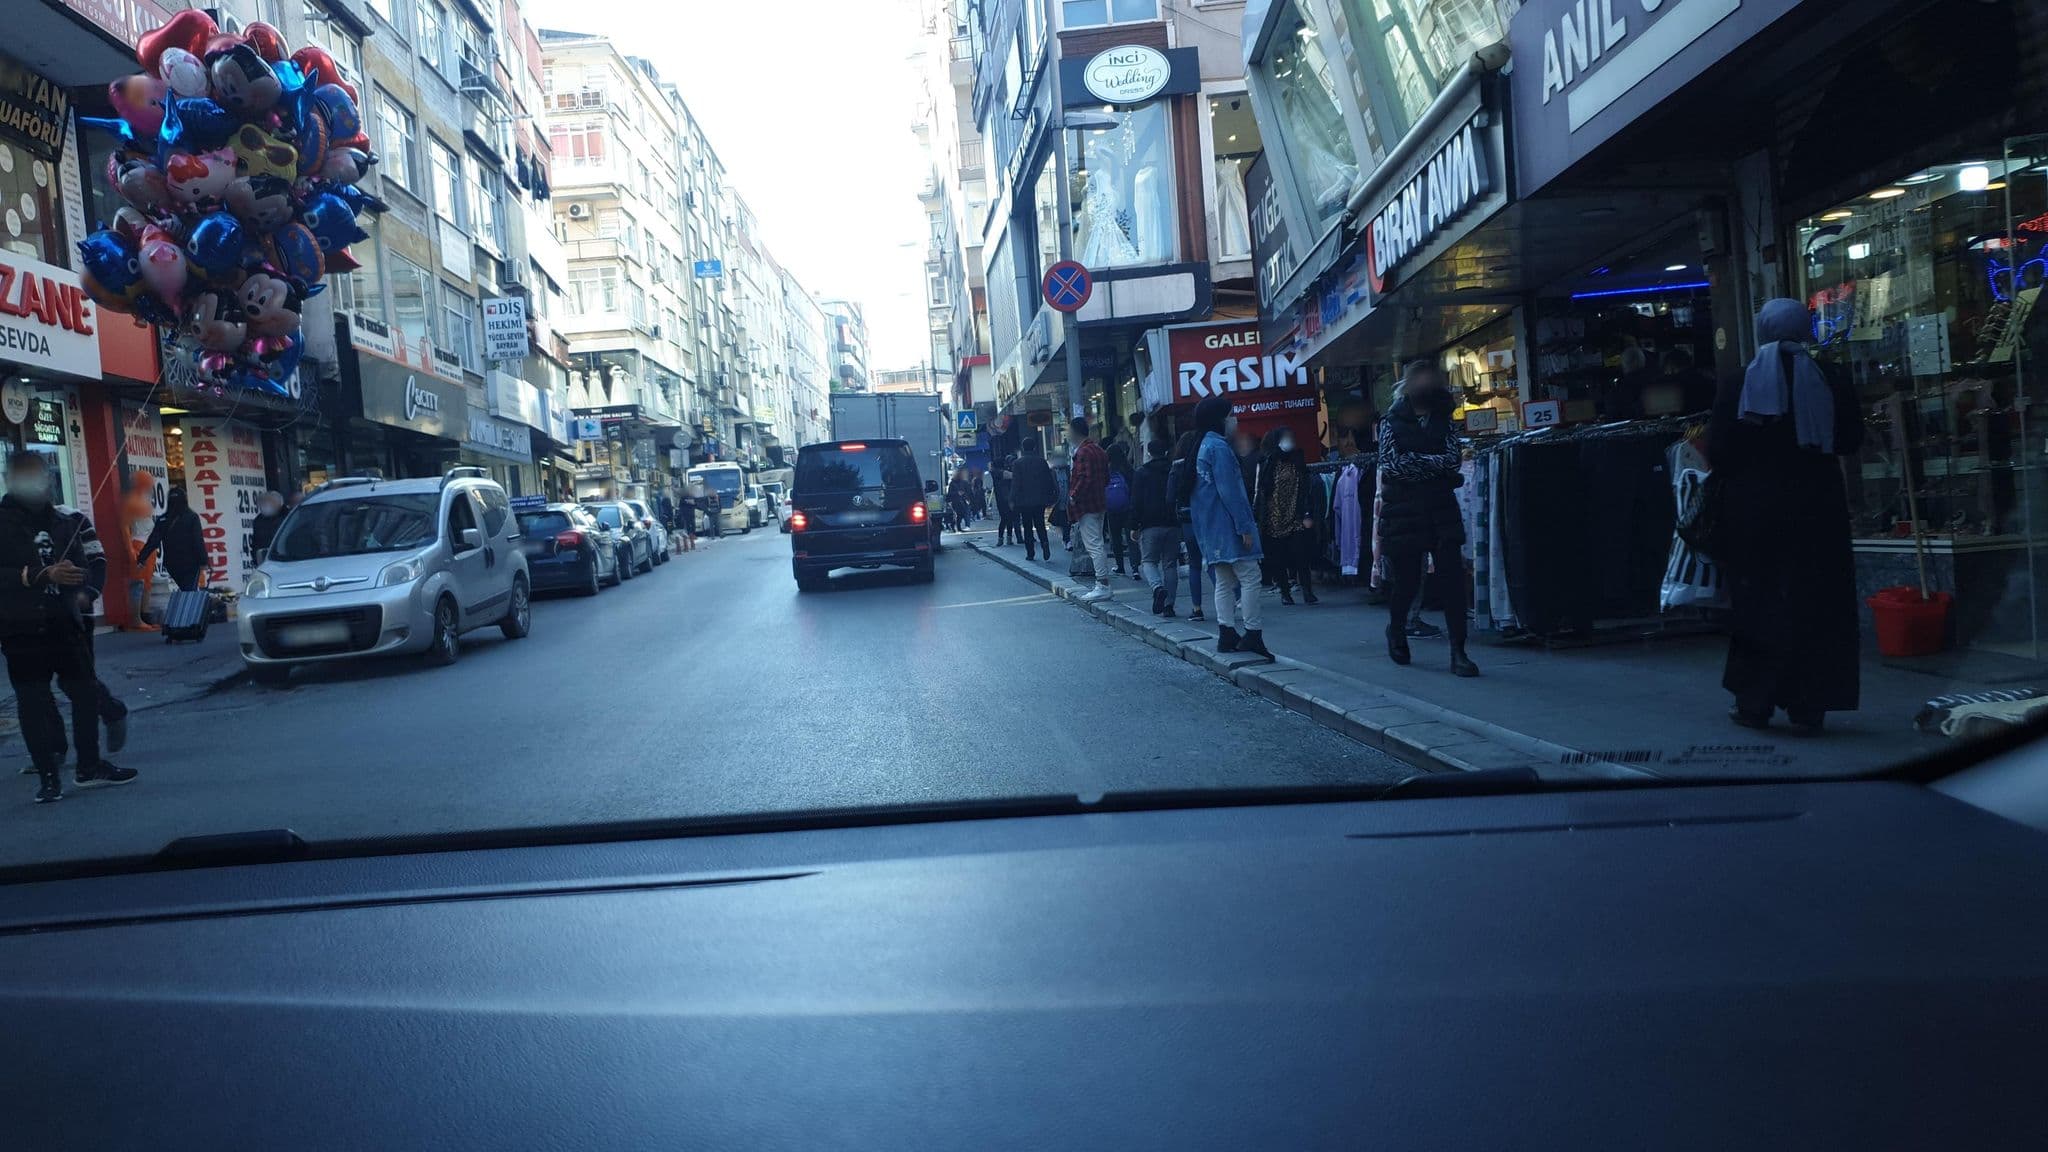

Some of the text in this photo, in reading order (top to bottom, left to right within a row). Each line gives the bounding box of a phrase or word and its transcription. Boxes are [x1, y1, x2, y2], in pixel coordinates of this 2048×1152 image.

[1542, 0, 1627, 106] ANIL
[1105, 67, 1156, 91] Wedding
[1427, 122, 1479, 233] AVM
[1250, 175, 1283, 252] TUĞB
[488, 317, 523, 331] HEKİMİ
[499, 299, 522, 317] DİŞ
[0, 325, 51, 357] SEVDA
[1533, 409, 1553, 423] 25
[190, 425, 230, 583] KAPATIYORUZ
